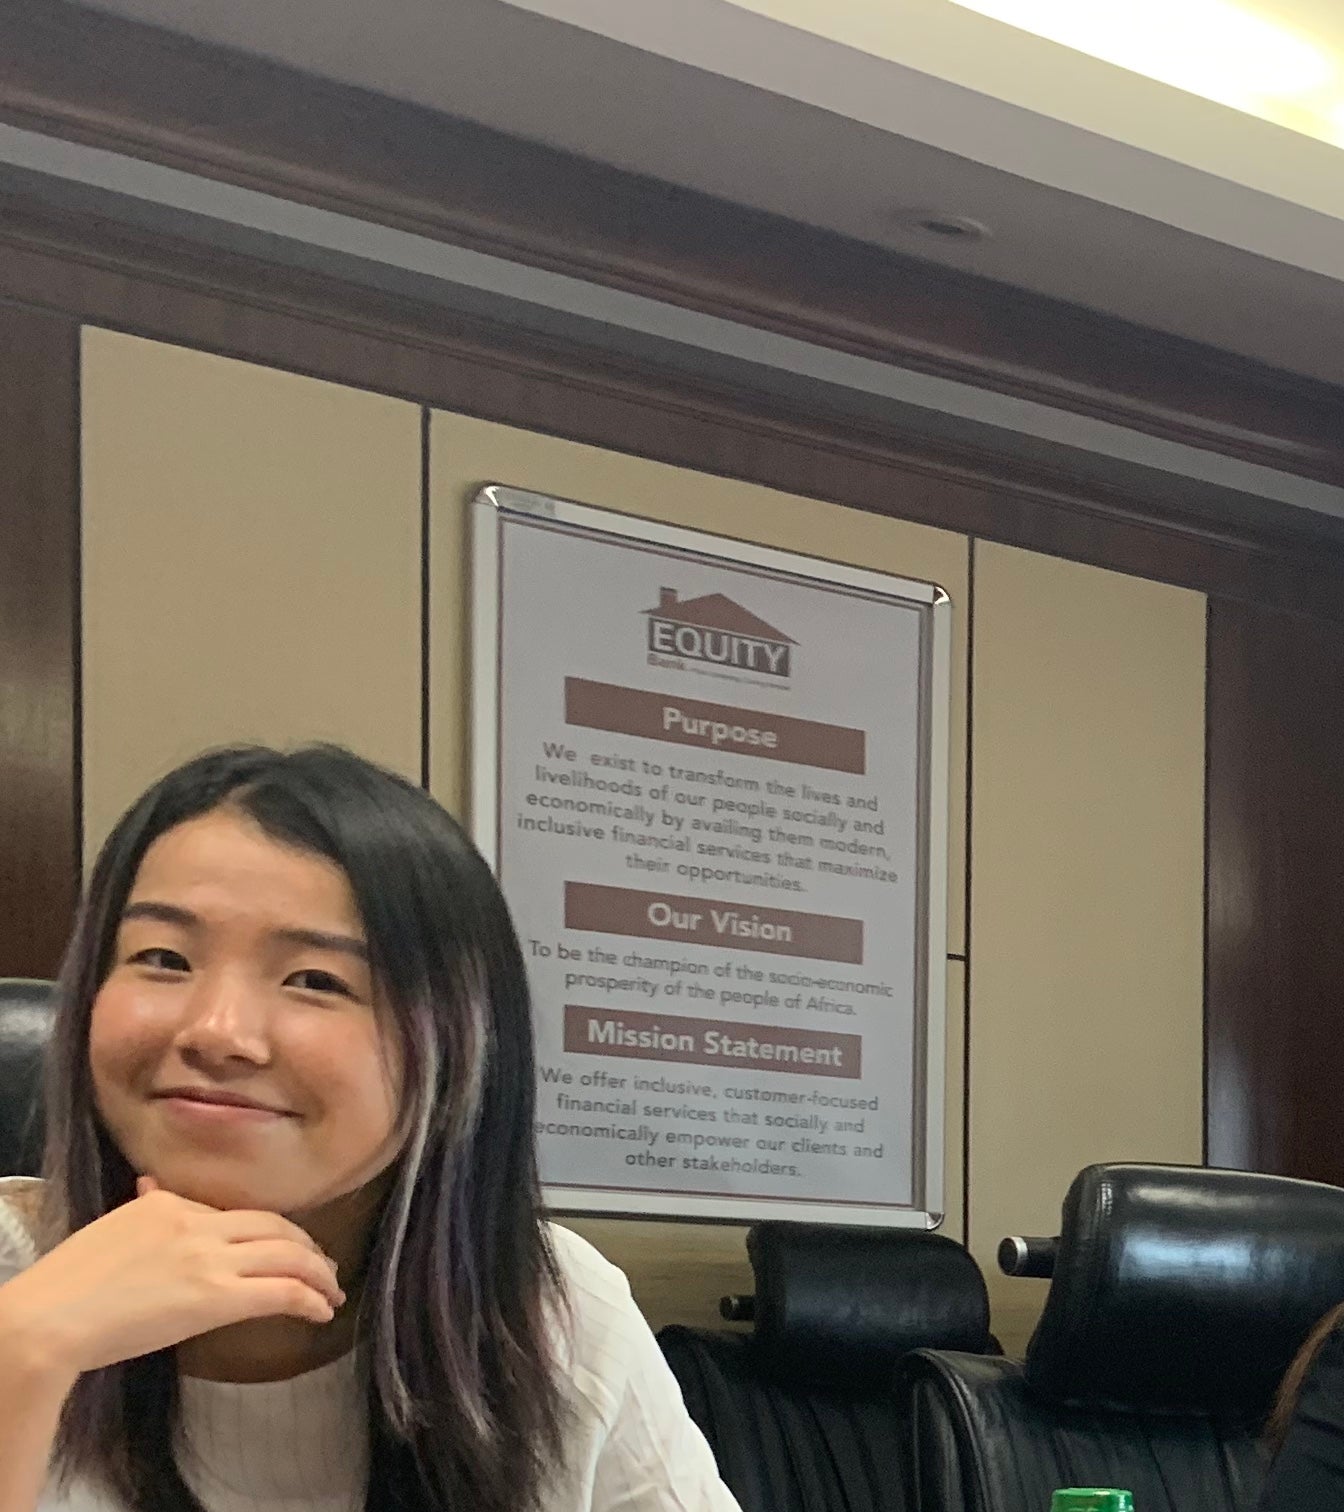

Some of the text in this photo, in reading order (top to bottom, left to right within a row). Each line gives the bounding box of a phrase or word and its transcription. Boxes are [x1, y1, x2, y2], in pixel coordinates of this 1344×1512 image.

[653, 621, 787, 672] EQUITY
[662, 706, 778, 748] Purpose
[543, 741, 878, 812] We exist to transform the lives and
[526, 792, 654, 827] economically
[661, 809, 684, 831] by
[691, 817, 762, 843] availing
[768, 826, 814, 847] them
[535, 764, 885, 835] livelihoods of our people socially and
[517, 812, 898, 883] inclusive financial services that maximize
[625, 852, 671, 873] their
[648, 901, 792, 942] Our Vision
[528, 939, 894, 998] To be the champion of the socio-economic
[565, 972, 857, 1016] prosperity of the people of Africa.
[588, 1019, 843, 1067] Mission Statement
[540, 1066, 879, 1111] We offer inclusive, customer-focused
[556, 1092, 865, 1134] financial services that socially and
[533, 1121, 884, 1158] economically empower our clients and
[625, 1150, 802, 1177] other stakeholders.
